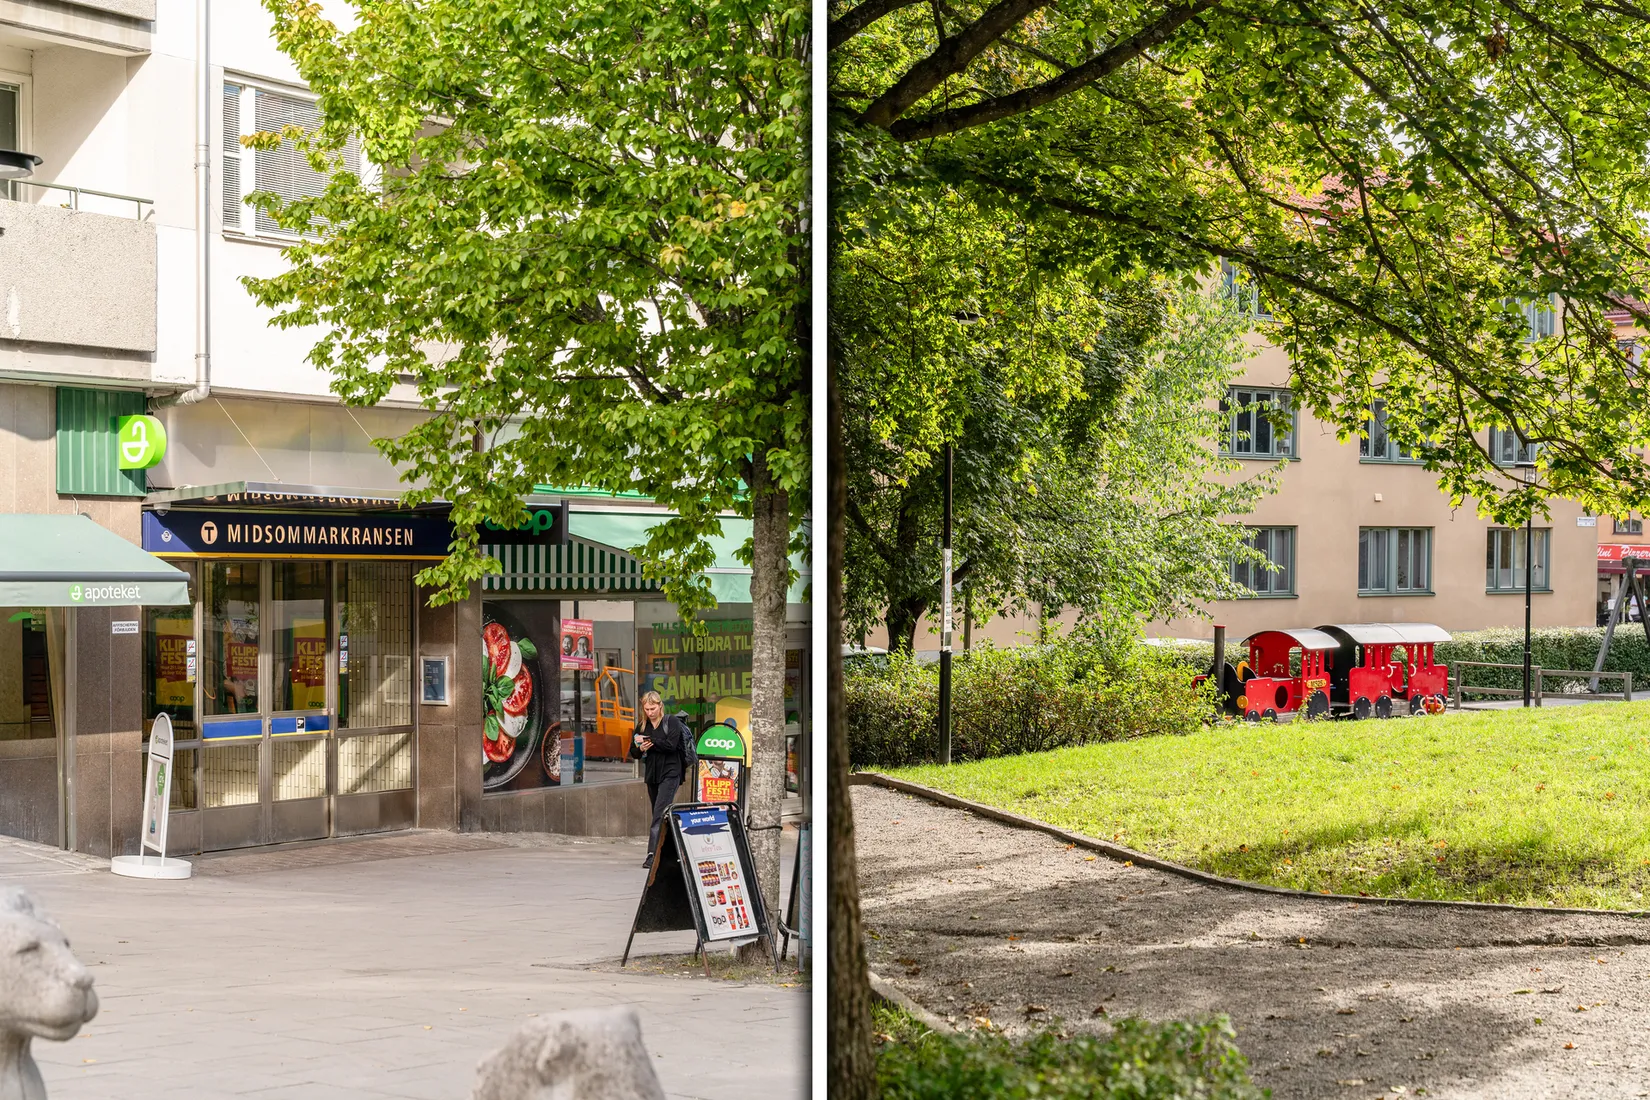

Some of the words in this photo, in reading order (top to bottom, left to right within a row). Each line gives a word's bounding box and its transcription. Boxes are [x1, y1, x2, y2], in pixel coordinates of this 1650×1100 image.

[484, 509, 553, 536] cop
[227, 524, 413, 546] MIDSOMMARKRANSEN
[84, 584, 141, 602] apoteket
[159, 639, 186, 652] KLIP
[296, 641, 326, 655] KLIP
[653, 638, 680, 654] VILL
[682, 637, 694, 653] VI
[696, 635, 732, 653] BIDRA
[160, 652, 187, 665] FEST
[232, 656, 257, 667] FEST!
[298, 655, 325, 669] FES
[653, 671, 752, 700] SAMHÄLLE
[704, 738, 736, 751] coop
[706, 780, 731, 788] KLIPP
[707, 787, 730, 796] FEST!
